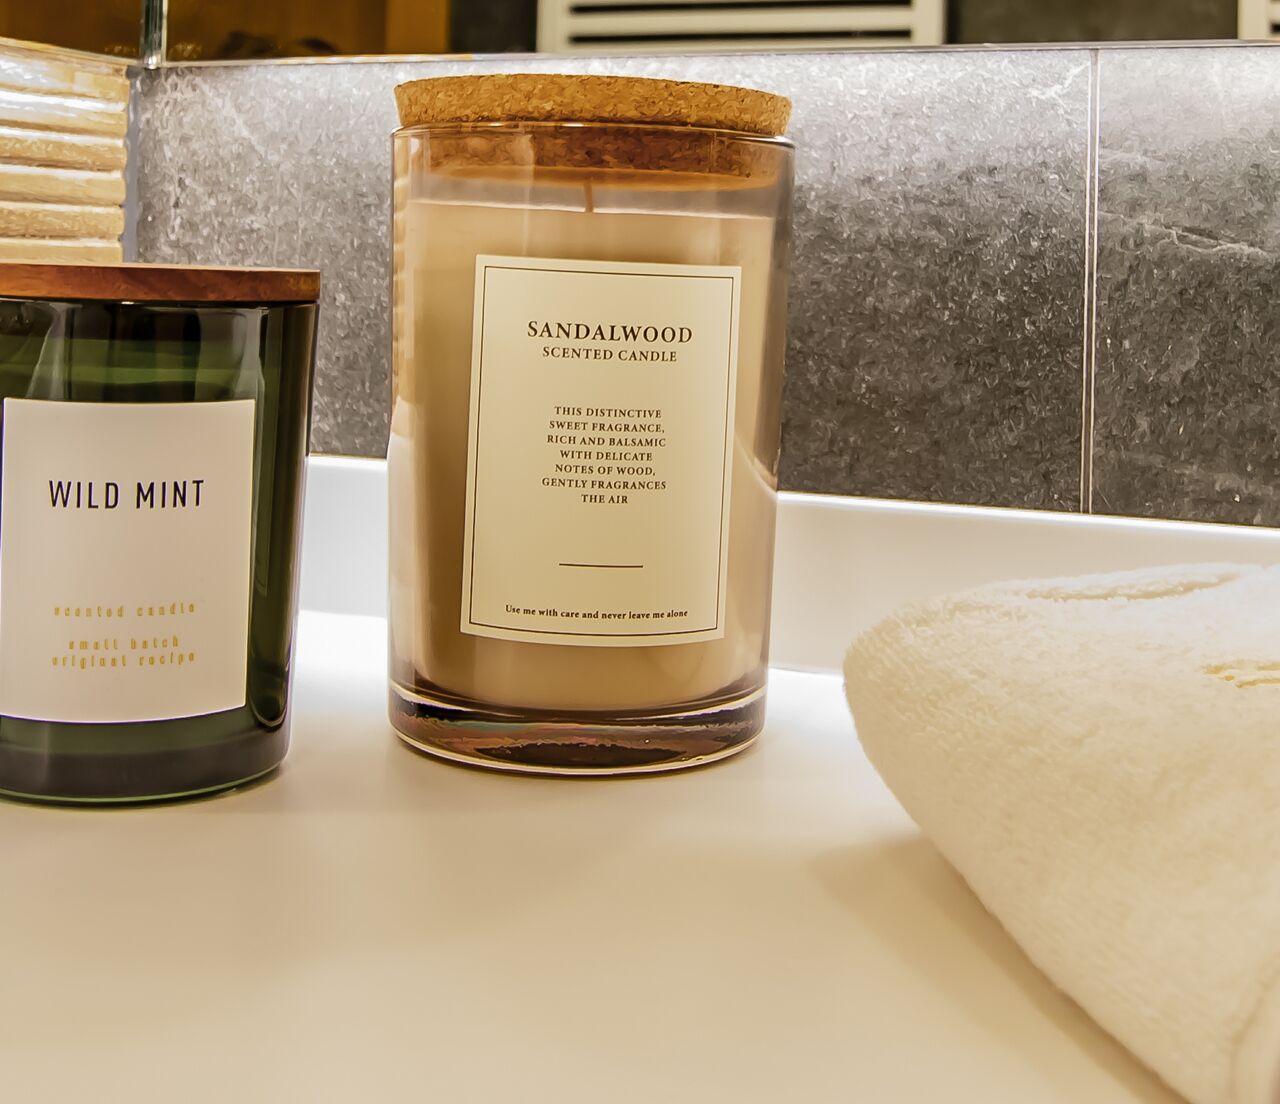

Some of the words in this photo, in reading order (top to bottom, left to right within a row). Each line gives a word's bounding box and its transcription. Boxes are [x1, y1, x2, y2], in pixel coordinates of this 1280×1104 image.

[527, 320, 693, 344] SANDALWOOD
[542, 346, 614, 360] SCENTED
[618, 350, 678, 362] CANDLE
[554, 406, 583, 417] THIS
[586, 406, 662, 419] DISTINCTIVE
[549, 420, 589, 431] SWEET
[591, 421, 665, 433] FRAGRANCE,
[547, 435, 577, 445] RICH
[579, 435, 606, 446] AND
[609, 436, 666, 447] BALSAMIC
[560, 449, 593, 461] WITH
[596, 451, 653, 462] DELICATE
[555, 464, 595, 475] NOTES
[597, 465, 613, 476] OF
[616, 465, 656, 477] WOOD,
[541, 477, 588, 490] GENTLY
[591, 479, 667, 490] FRAGRANCES
[48, 480, 120, 510] WILD
[135, 479, 205, 510] MINT
[581, 494, 606, 504] THE
[608, 494, 629, 505] AIR
[505, 604, 520, 615] Use
[538, 606, 558, 617] with
[560, 610, 579, 618] care
[582, 610, 598, 619] and
[601, 611, 626, 620] never
[629, 610, 651, 620] leave
[653, 611, 665, 619] me
[667, 608, 688, 619] alone
